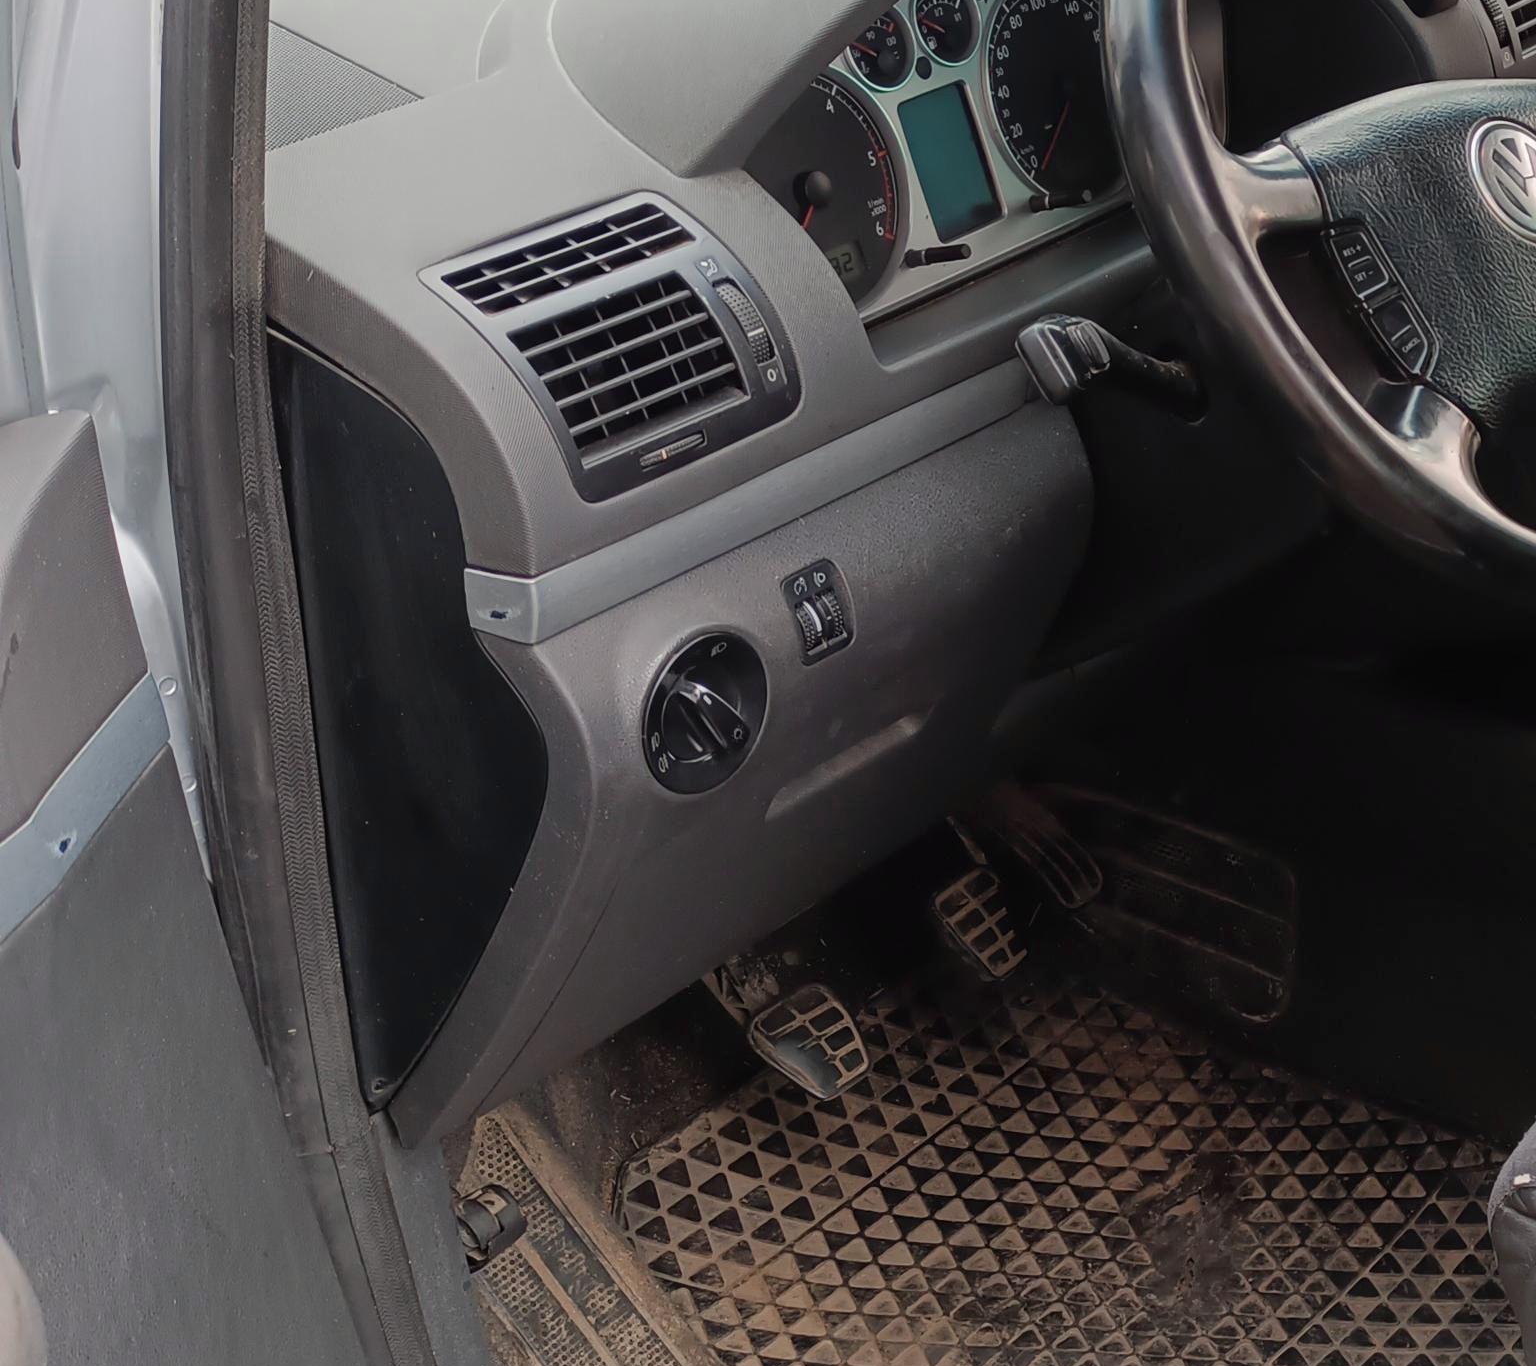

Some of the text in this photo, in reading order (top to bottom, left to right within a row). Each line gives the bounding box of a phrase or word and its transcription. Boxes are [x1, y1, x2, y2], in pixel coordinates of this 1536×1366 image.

[1064, 0, 1080, 16] 140
[1009, 14, 1023, 29] 80
[997, 45, 1010, 60] 60
[998, 85, 1010, 99] 40
[826, 98, 835, 114] 4
[1010, 123, 1023, 138] 20
[867, 150, 877, 167] 5
[1030, 155, 1038, 168] 0
[876, 221, 885, 236] 6
